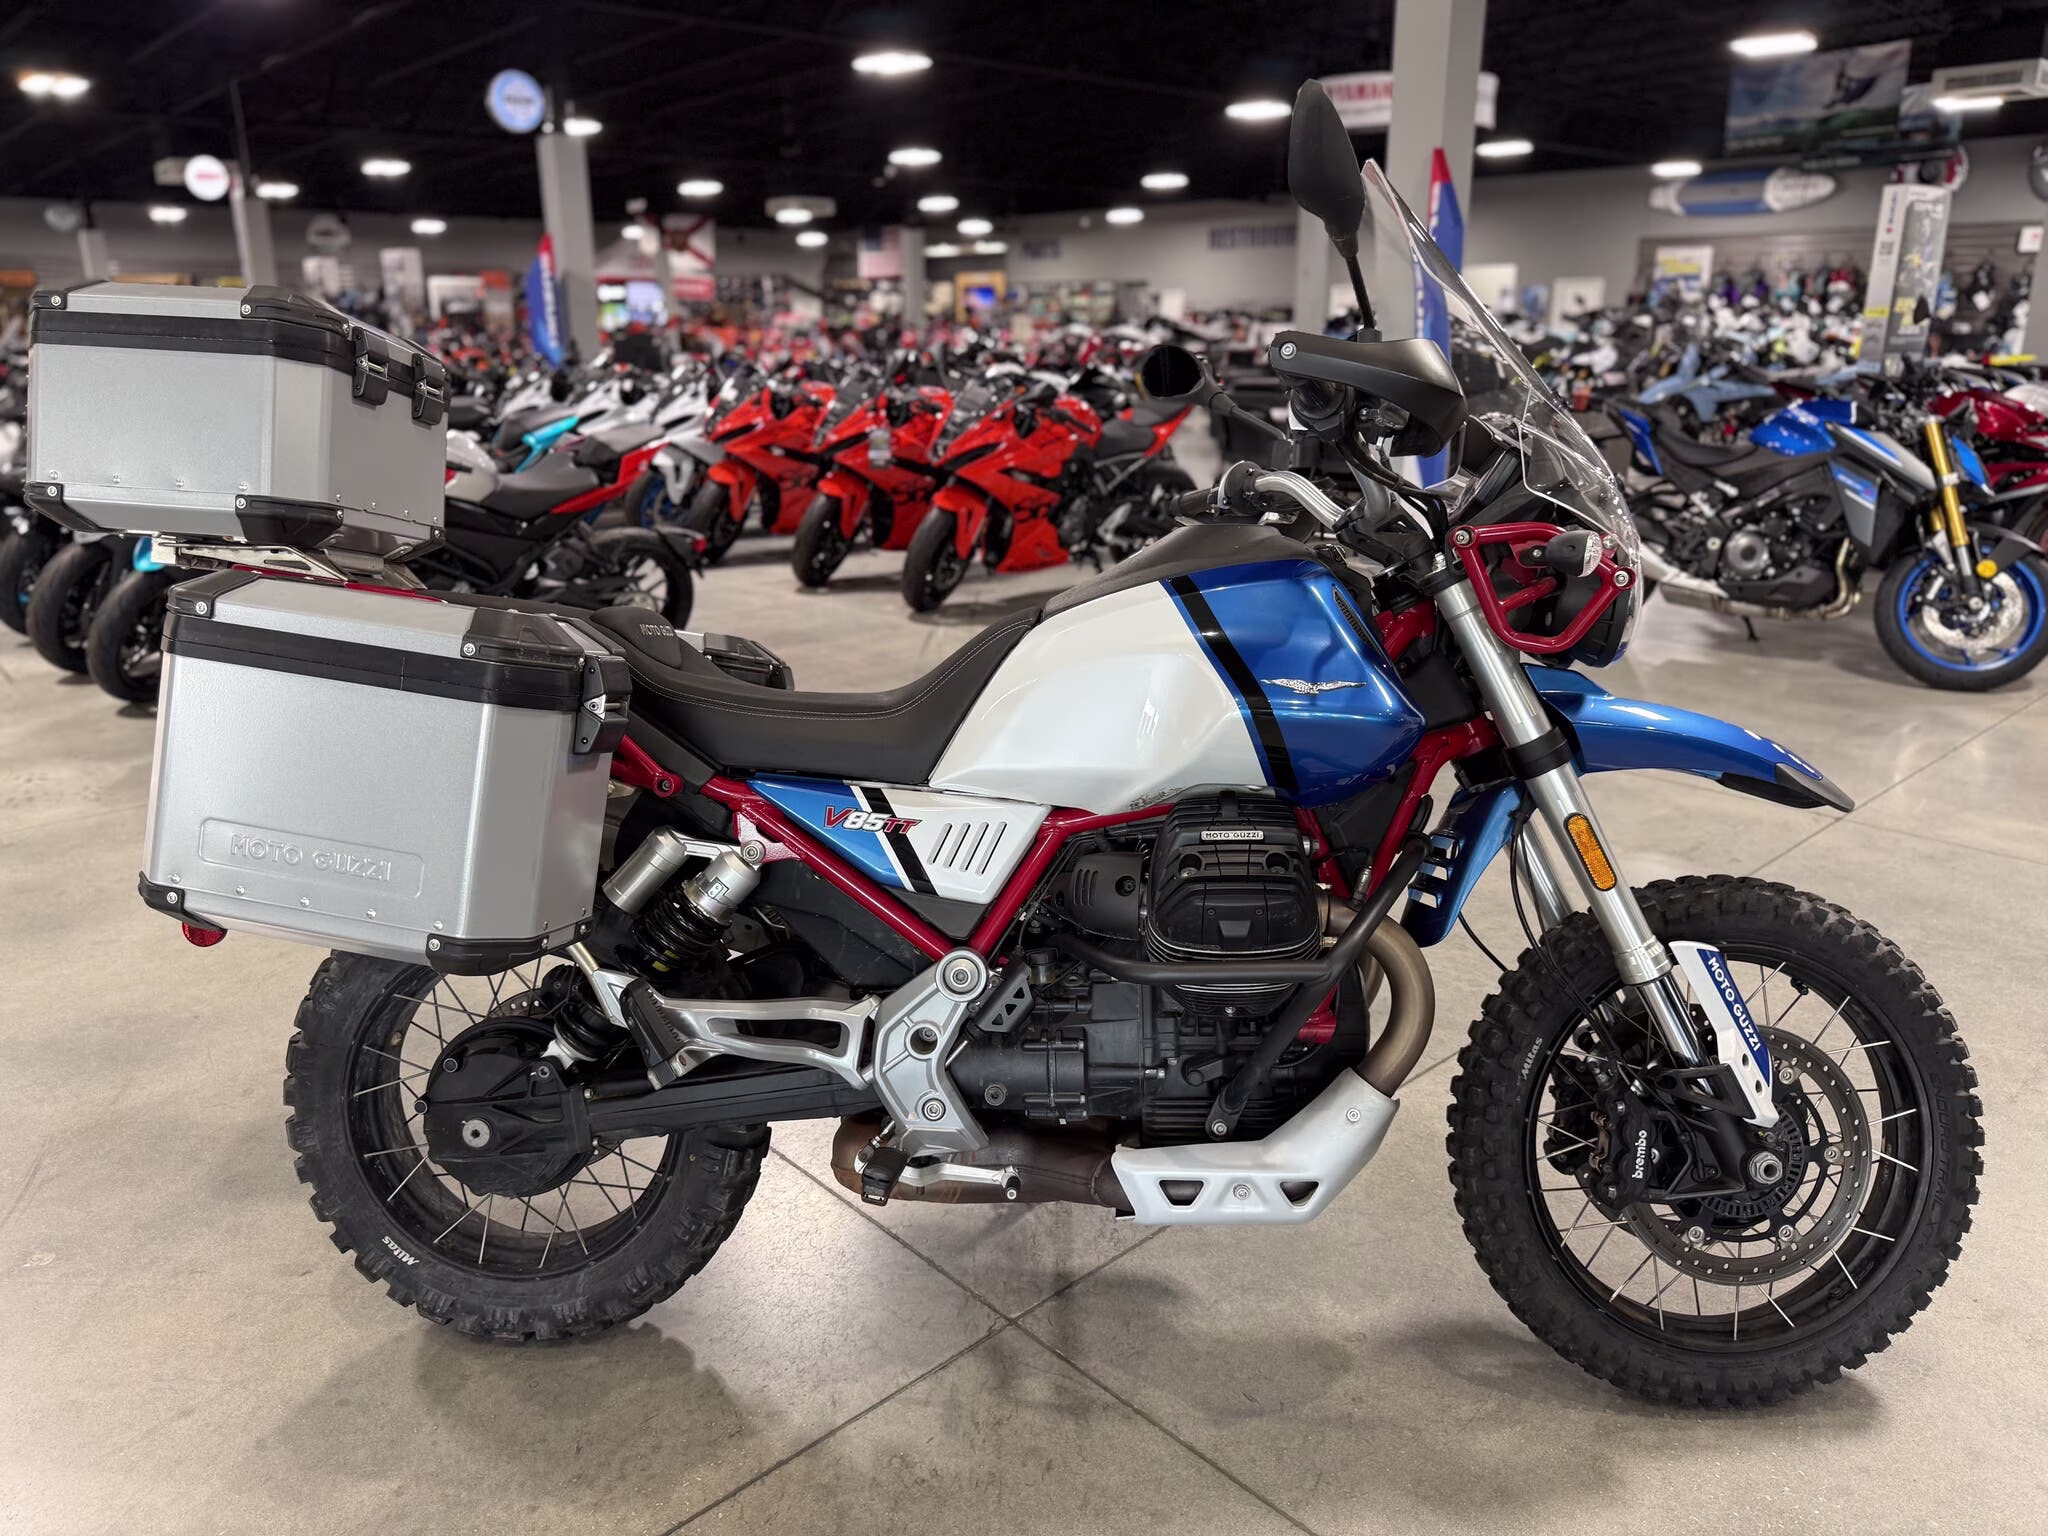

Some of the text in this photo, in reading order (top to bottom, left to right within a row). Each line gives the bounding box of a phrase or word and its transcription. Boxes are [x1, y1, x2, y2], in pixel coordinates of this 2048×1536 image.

[230, 834, 392, 881] MOTO GUZZI
[1708, 956, 1761, 1052] MOTO GUZZI
[1521, 1036, 1543, 1080] Mitas
[1631, 1129, 1648, 1179] brembo
[381, 1235, 420, 1266] Mitas
